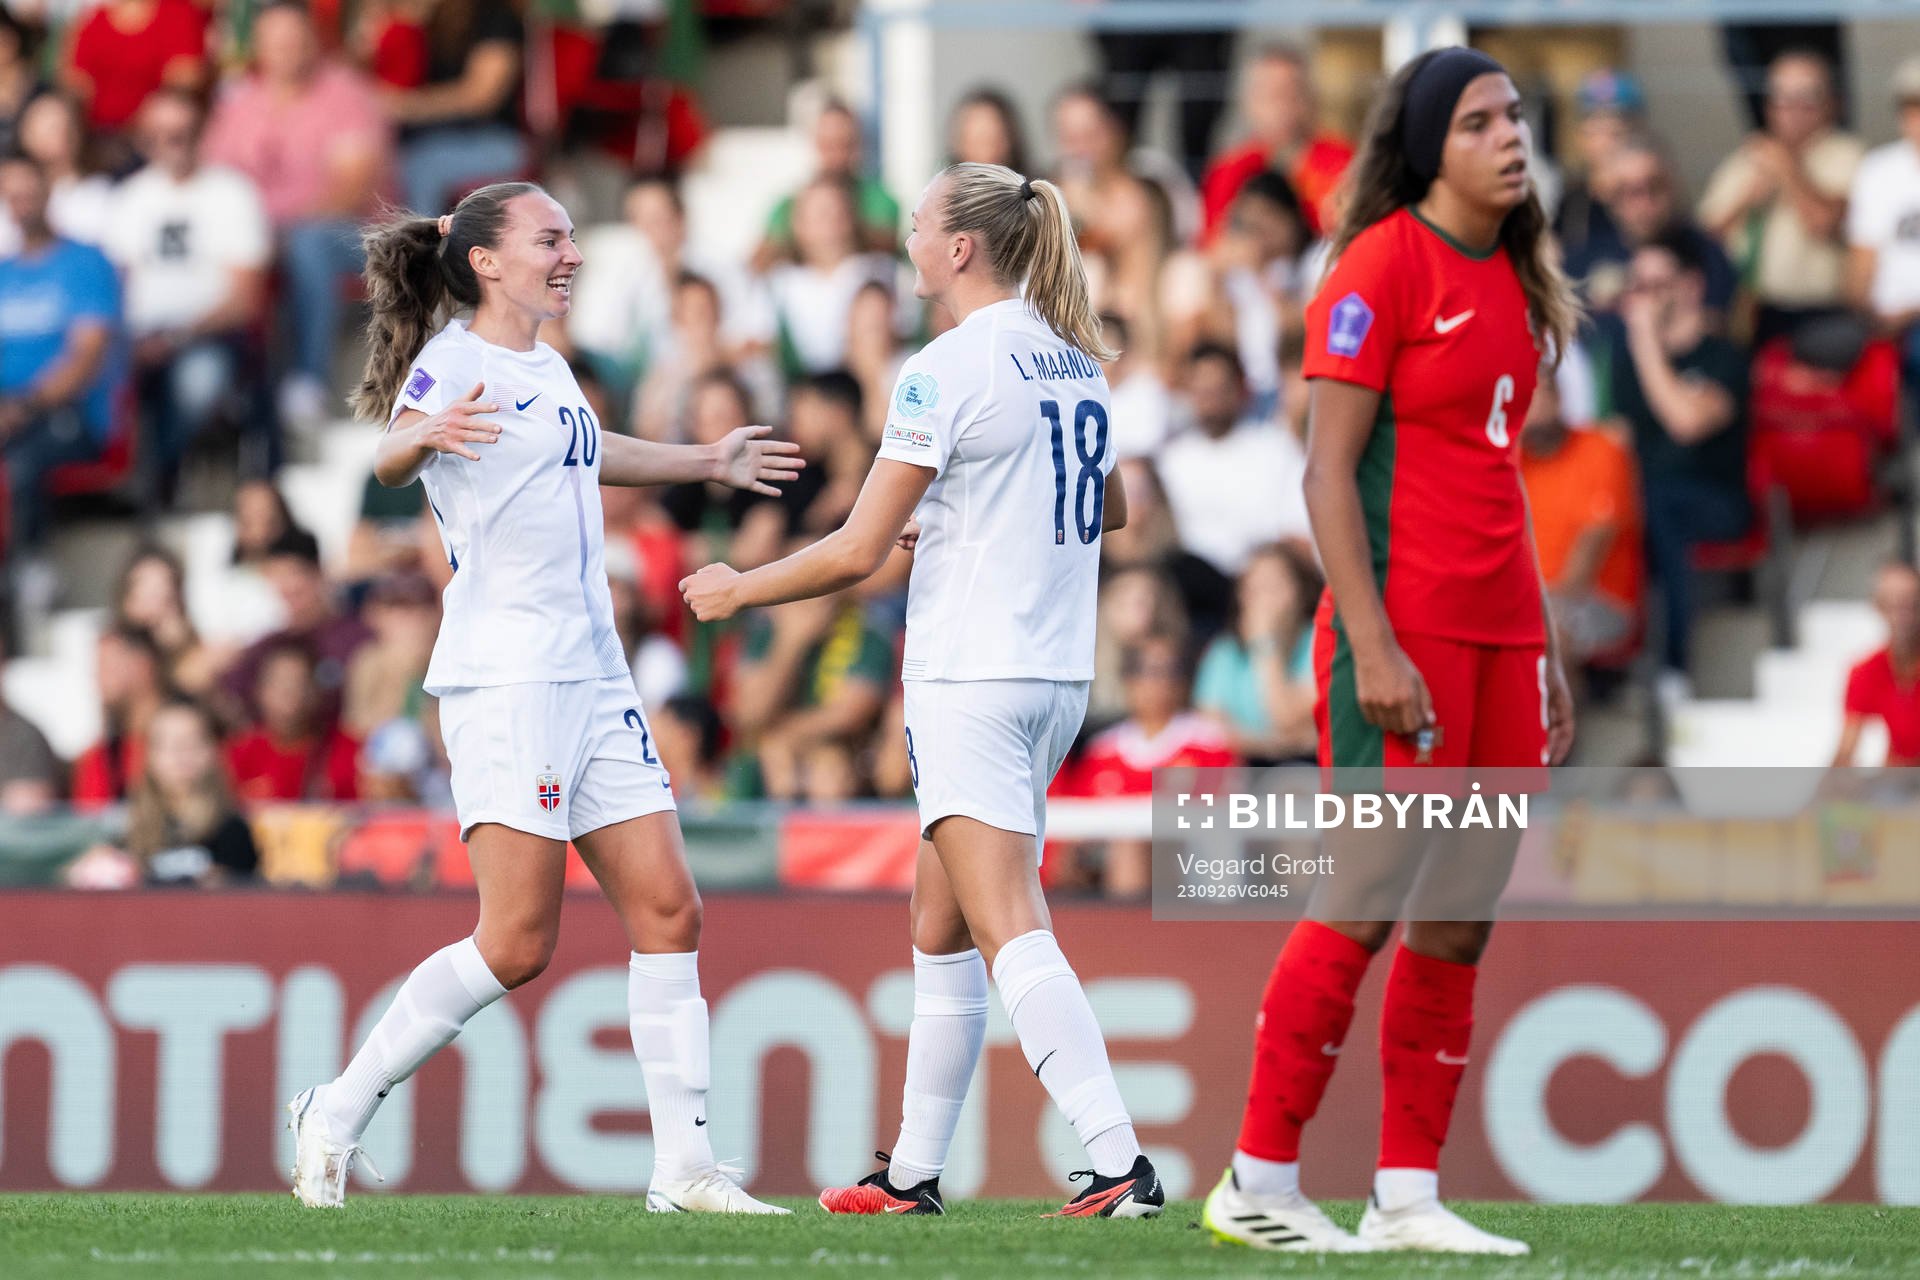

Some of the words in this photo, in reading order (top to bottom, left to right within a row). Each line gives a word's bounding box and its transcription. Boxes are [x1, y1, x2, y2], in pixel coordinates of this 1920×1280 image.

[1010, 353, 1033, 381] L.
[558, 406, 597, 467] 20
[885, 429, 932, 442] OUNDATION
[1486, 374, 1514, 448] 6
[1039, 399, 1108, 545] 18
[623, 708, 657, 764] 2
[1483, 982, 1920, 1204] CO
